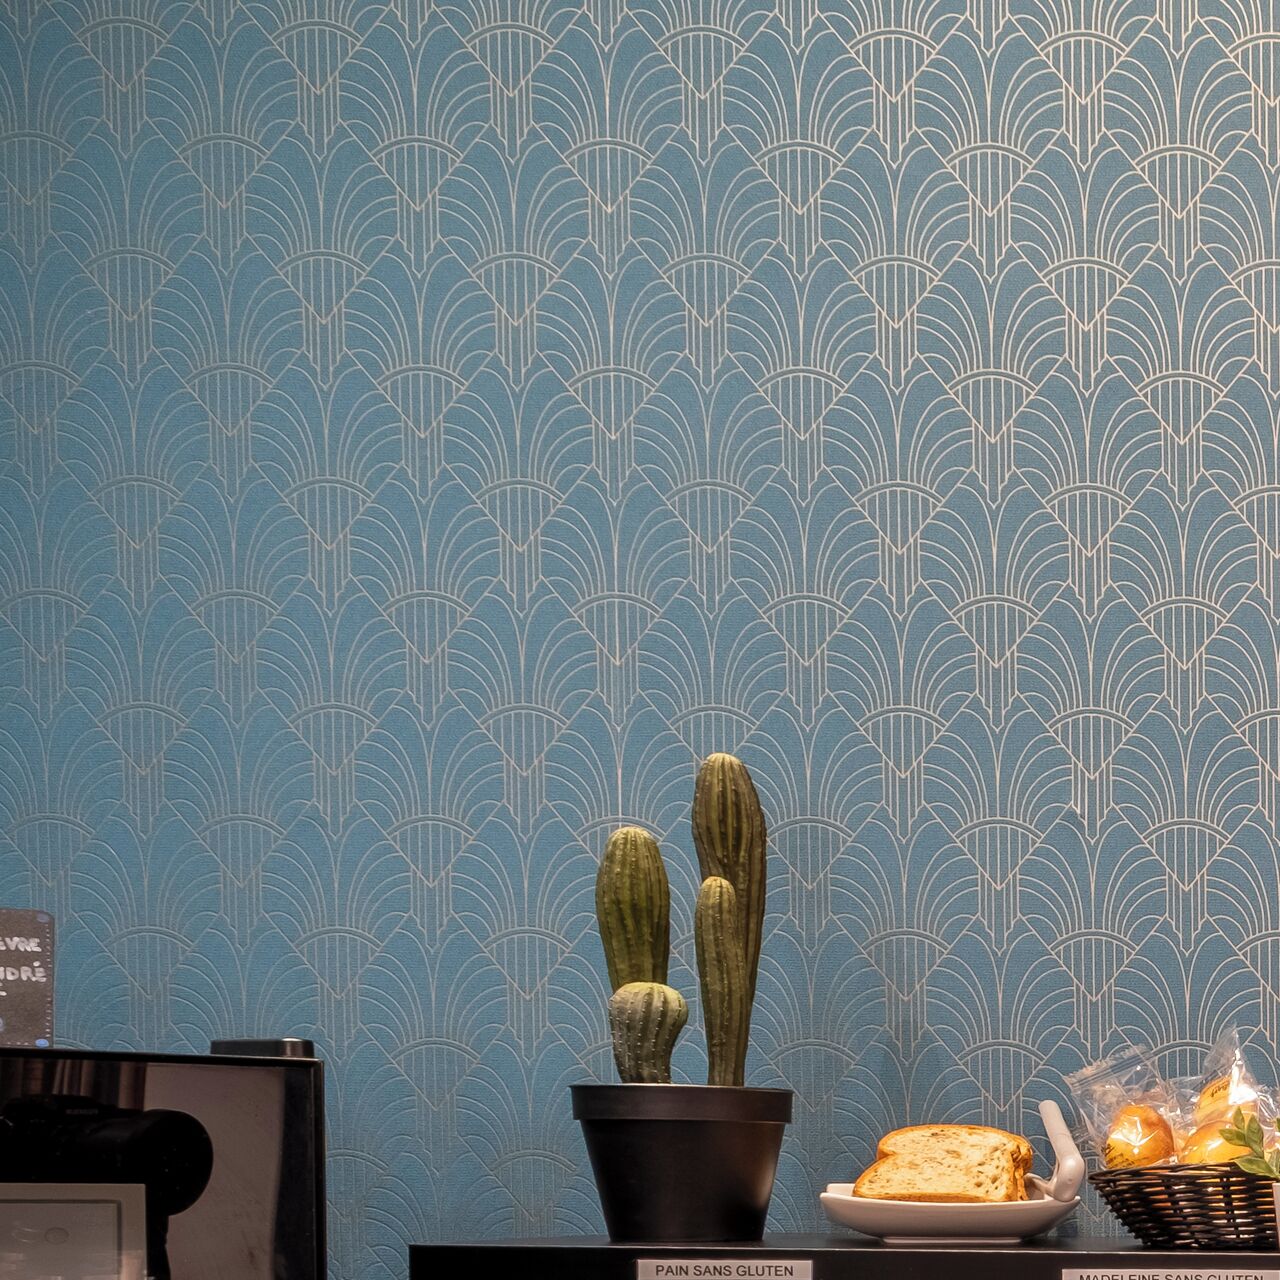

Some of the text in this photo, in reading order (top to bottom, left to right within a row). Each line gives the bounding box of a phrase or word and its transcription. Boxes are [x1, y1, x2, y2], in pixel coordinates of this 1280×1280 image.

[655, 1264, 794, 1277] PAIN SANS GLUTEN
